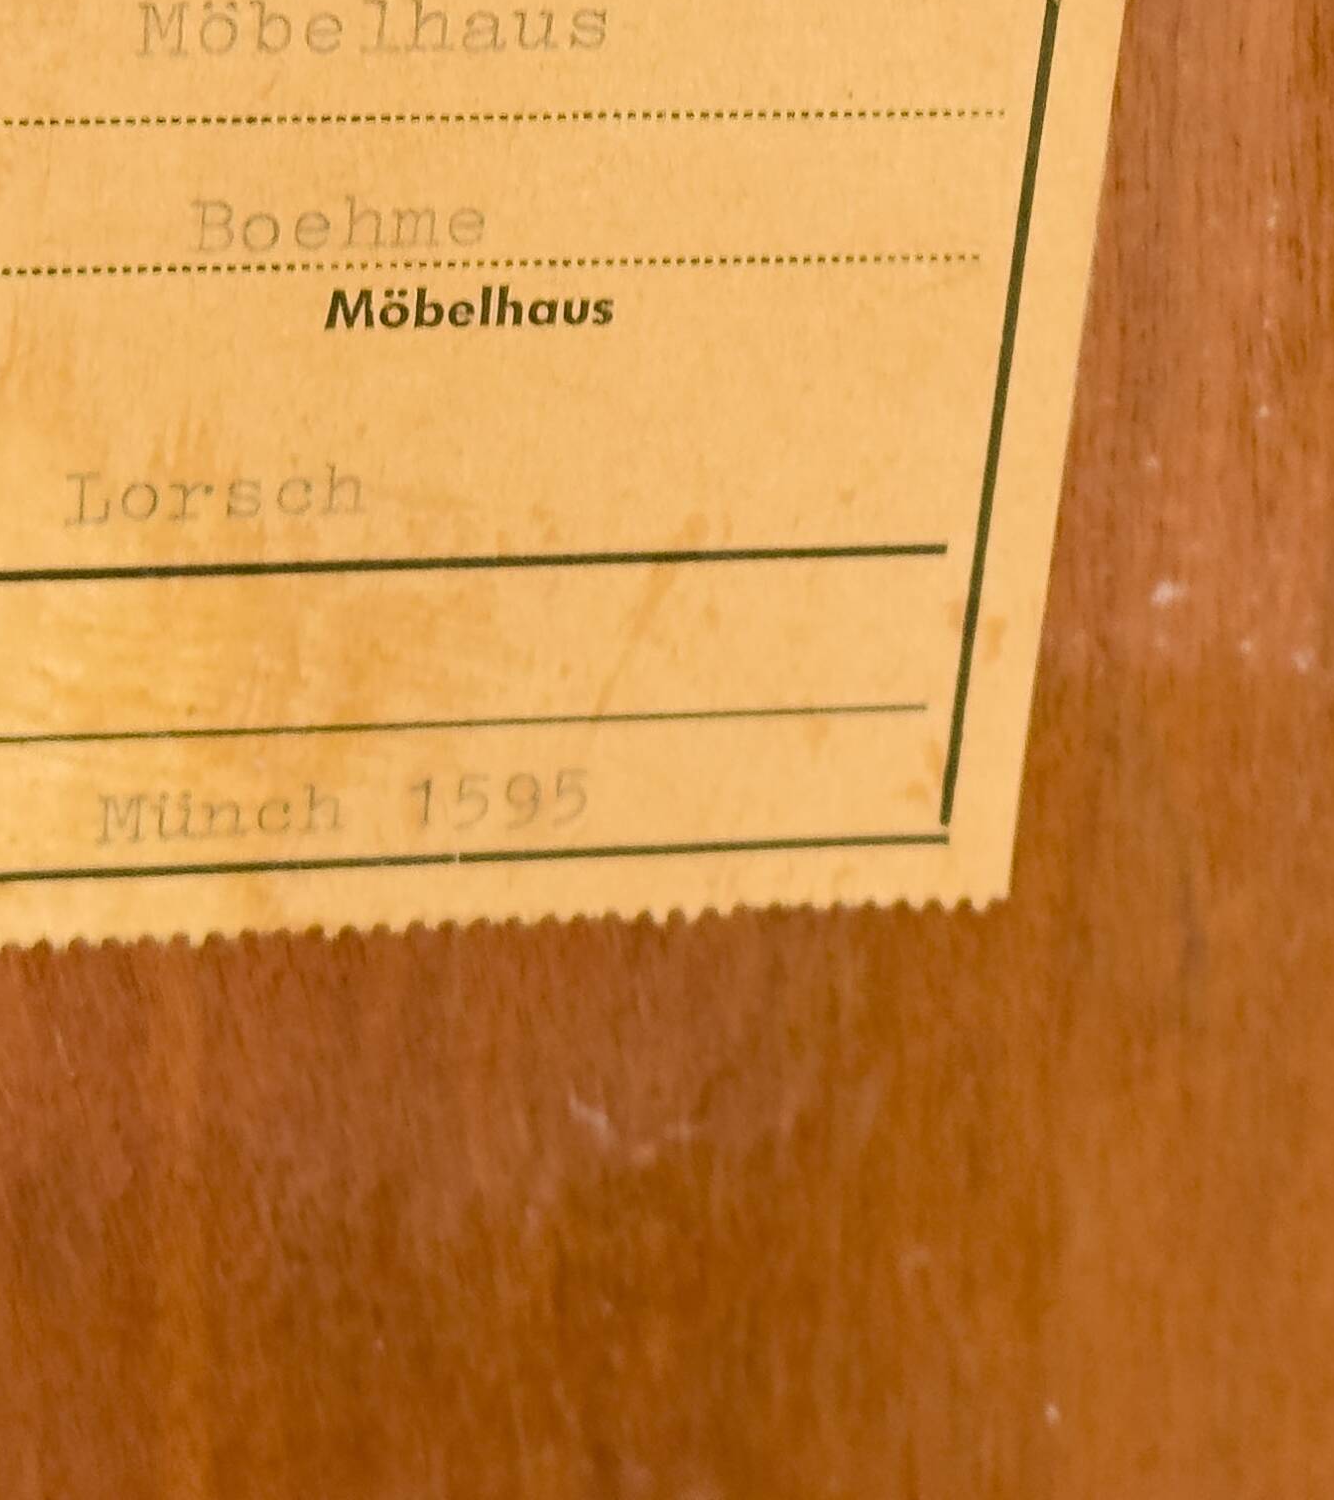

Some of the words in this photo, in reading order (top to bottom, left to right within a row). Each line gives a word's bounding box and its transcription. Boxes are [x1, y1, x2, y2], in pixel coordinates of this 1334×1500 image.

[190, 194, 487, 254] Boehme
[324, 285, 615, 331] Möbelhaus
[63, 463, 368, 528] Lorsch
[96, 783, 346, 847] Münch
[409, 767, 589, 831] 1595
